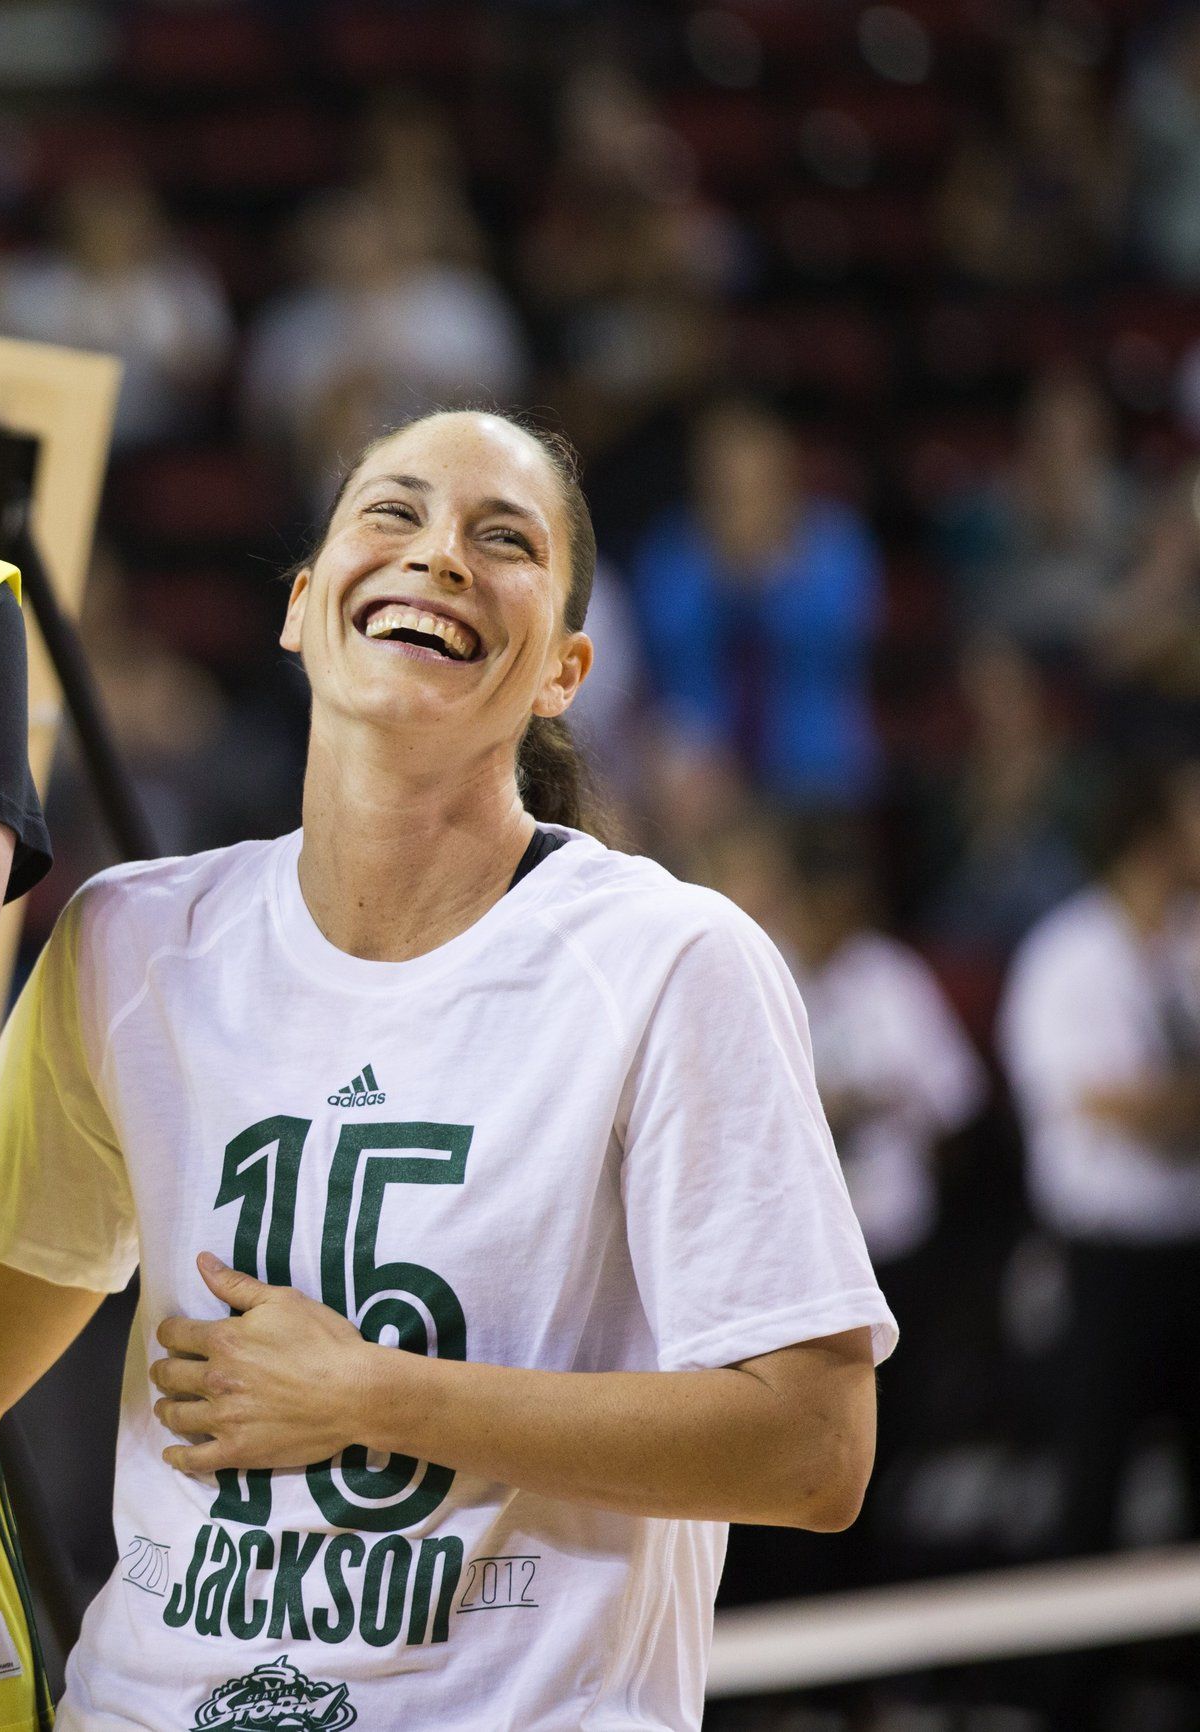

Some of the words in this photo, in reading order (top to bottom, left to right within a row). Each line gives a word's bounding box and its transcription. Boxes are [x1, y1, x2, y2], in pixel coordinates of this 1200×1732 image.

[327, 1091, 386, 1108] adidas
[210, 1114, 475, 1532] 15
[460, 1560, 536, 1608] 2012
[200, 1684, 347, 1730] STORM
[247, 1687, 297, 1702] SEATTLE
